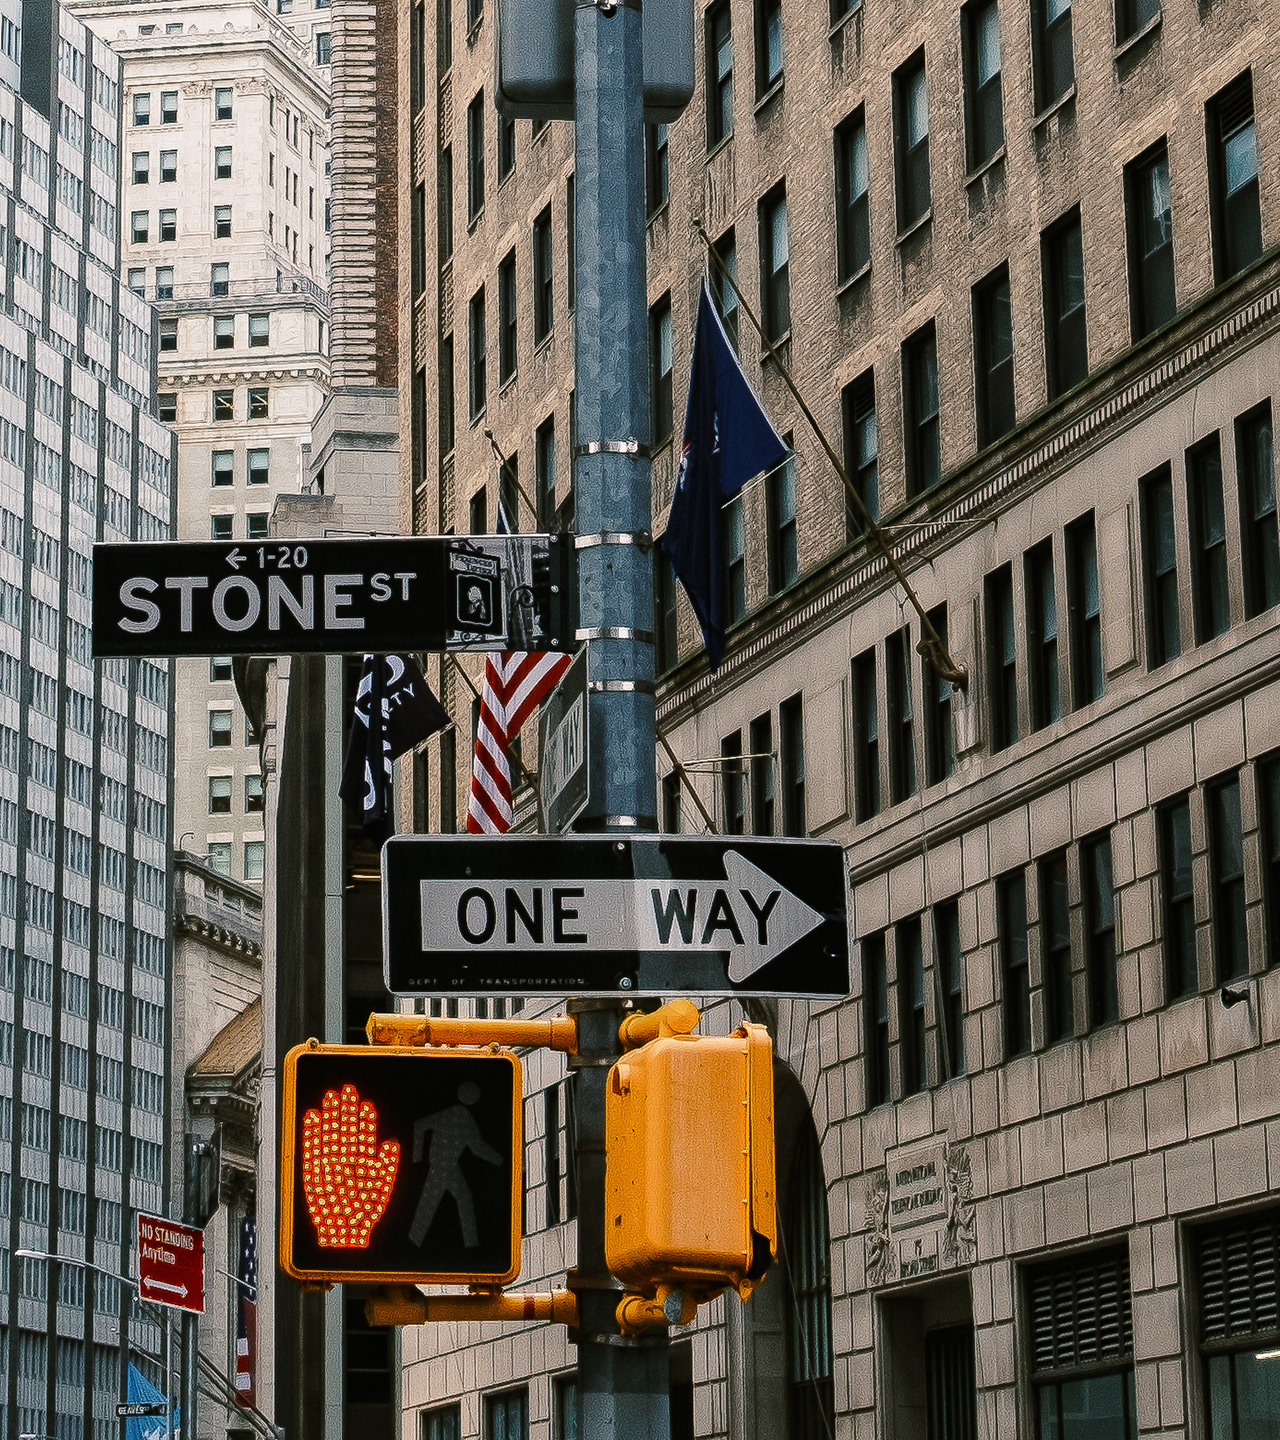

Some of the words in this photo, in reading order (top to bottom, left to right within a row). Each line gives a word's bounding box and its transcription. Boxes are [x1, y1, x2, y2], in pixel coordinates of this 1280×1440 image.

[257, 546, 308, 569] 1-20
[117, 575, 365, 633] STONE
[370, 572, 418, 602] ST
[456, 887, 588, 945] ONE
[650, 887, 782, 946] WAY
[141, 1223, 153, 1240] NO
[155, 1226, 194, 1251] STANDING
